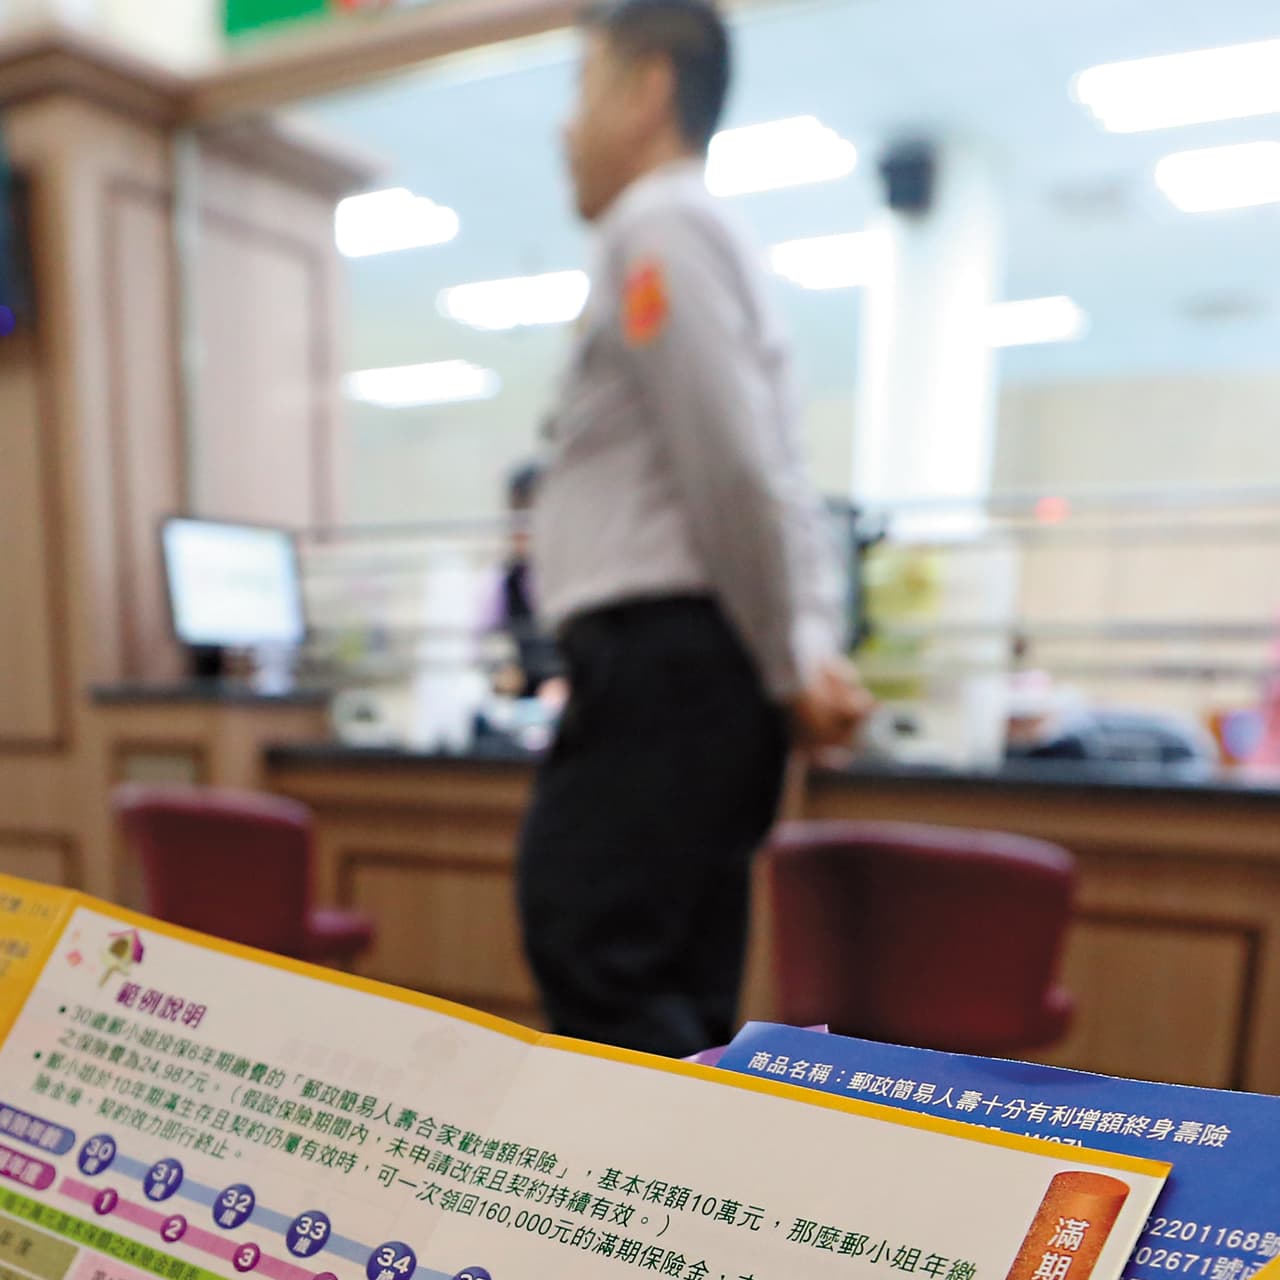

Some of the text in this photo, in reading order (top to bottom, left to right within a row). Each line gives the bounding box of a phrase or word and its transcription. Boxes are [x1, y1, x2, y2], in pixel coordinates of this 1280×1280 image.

[116, 982, 207, 1029] 範例說明
[85, 1138, 114, 1159] 30
[151, 1162, 178, 1184] 31
[101, 1193, 111, 1209] 1
[221, 1189, 251, 1214] 32
[166, 1219, 181, 1238] 2
[295, 1216, 327, 1241] 33
[239, 1248, 255, 1266] 3
[376, 1247, 410, 1275] 34
